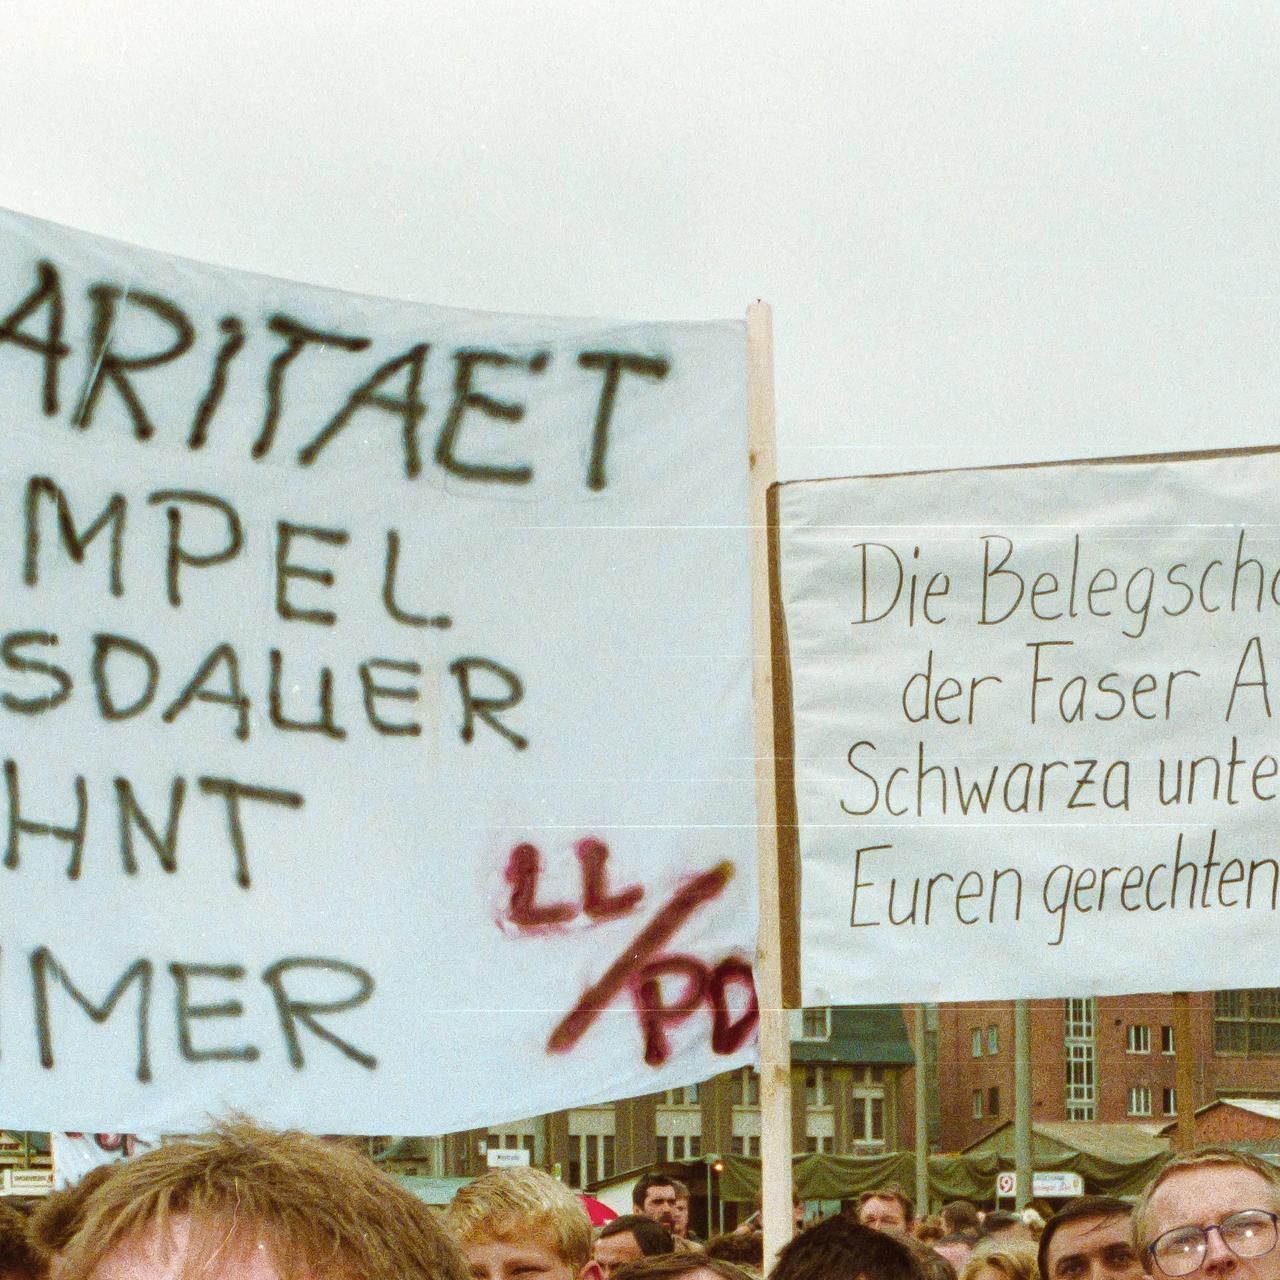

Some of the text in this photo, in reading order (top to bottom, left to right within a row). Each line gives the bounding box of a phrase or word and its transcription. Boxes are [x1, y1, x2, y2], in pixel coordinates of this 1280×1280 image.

[850, 543, 950, 627] Die
[901, 650, 1003, 726] der
[1025, 640, 1201, 726] Faser
[839, 740, 1132, 817] Schwarza
[850, 844, 1023, 928] Euren
[1042, 829, 1280, 946] gerechten
